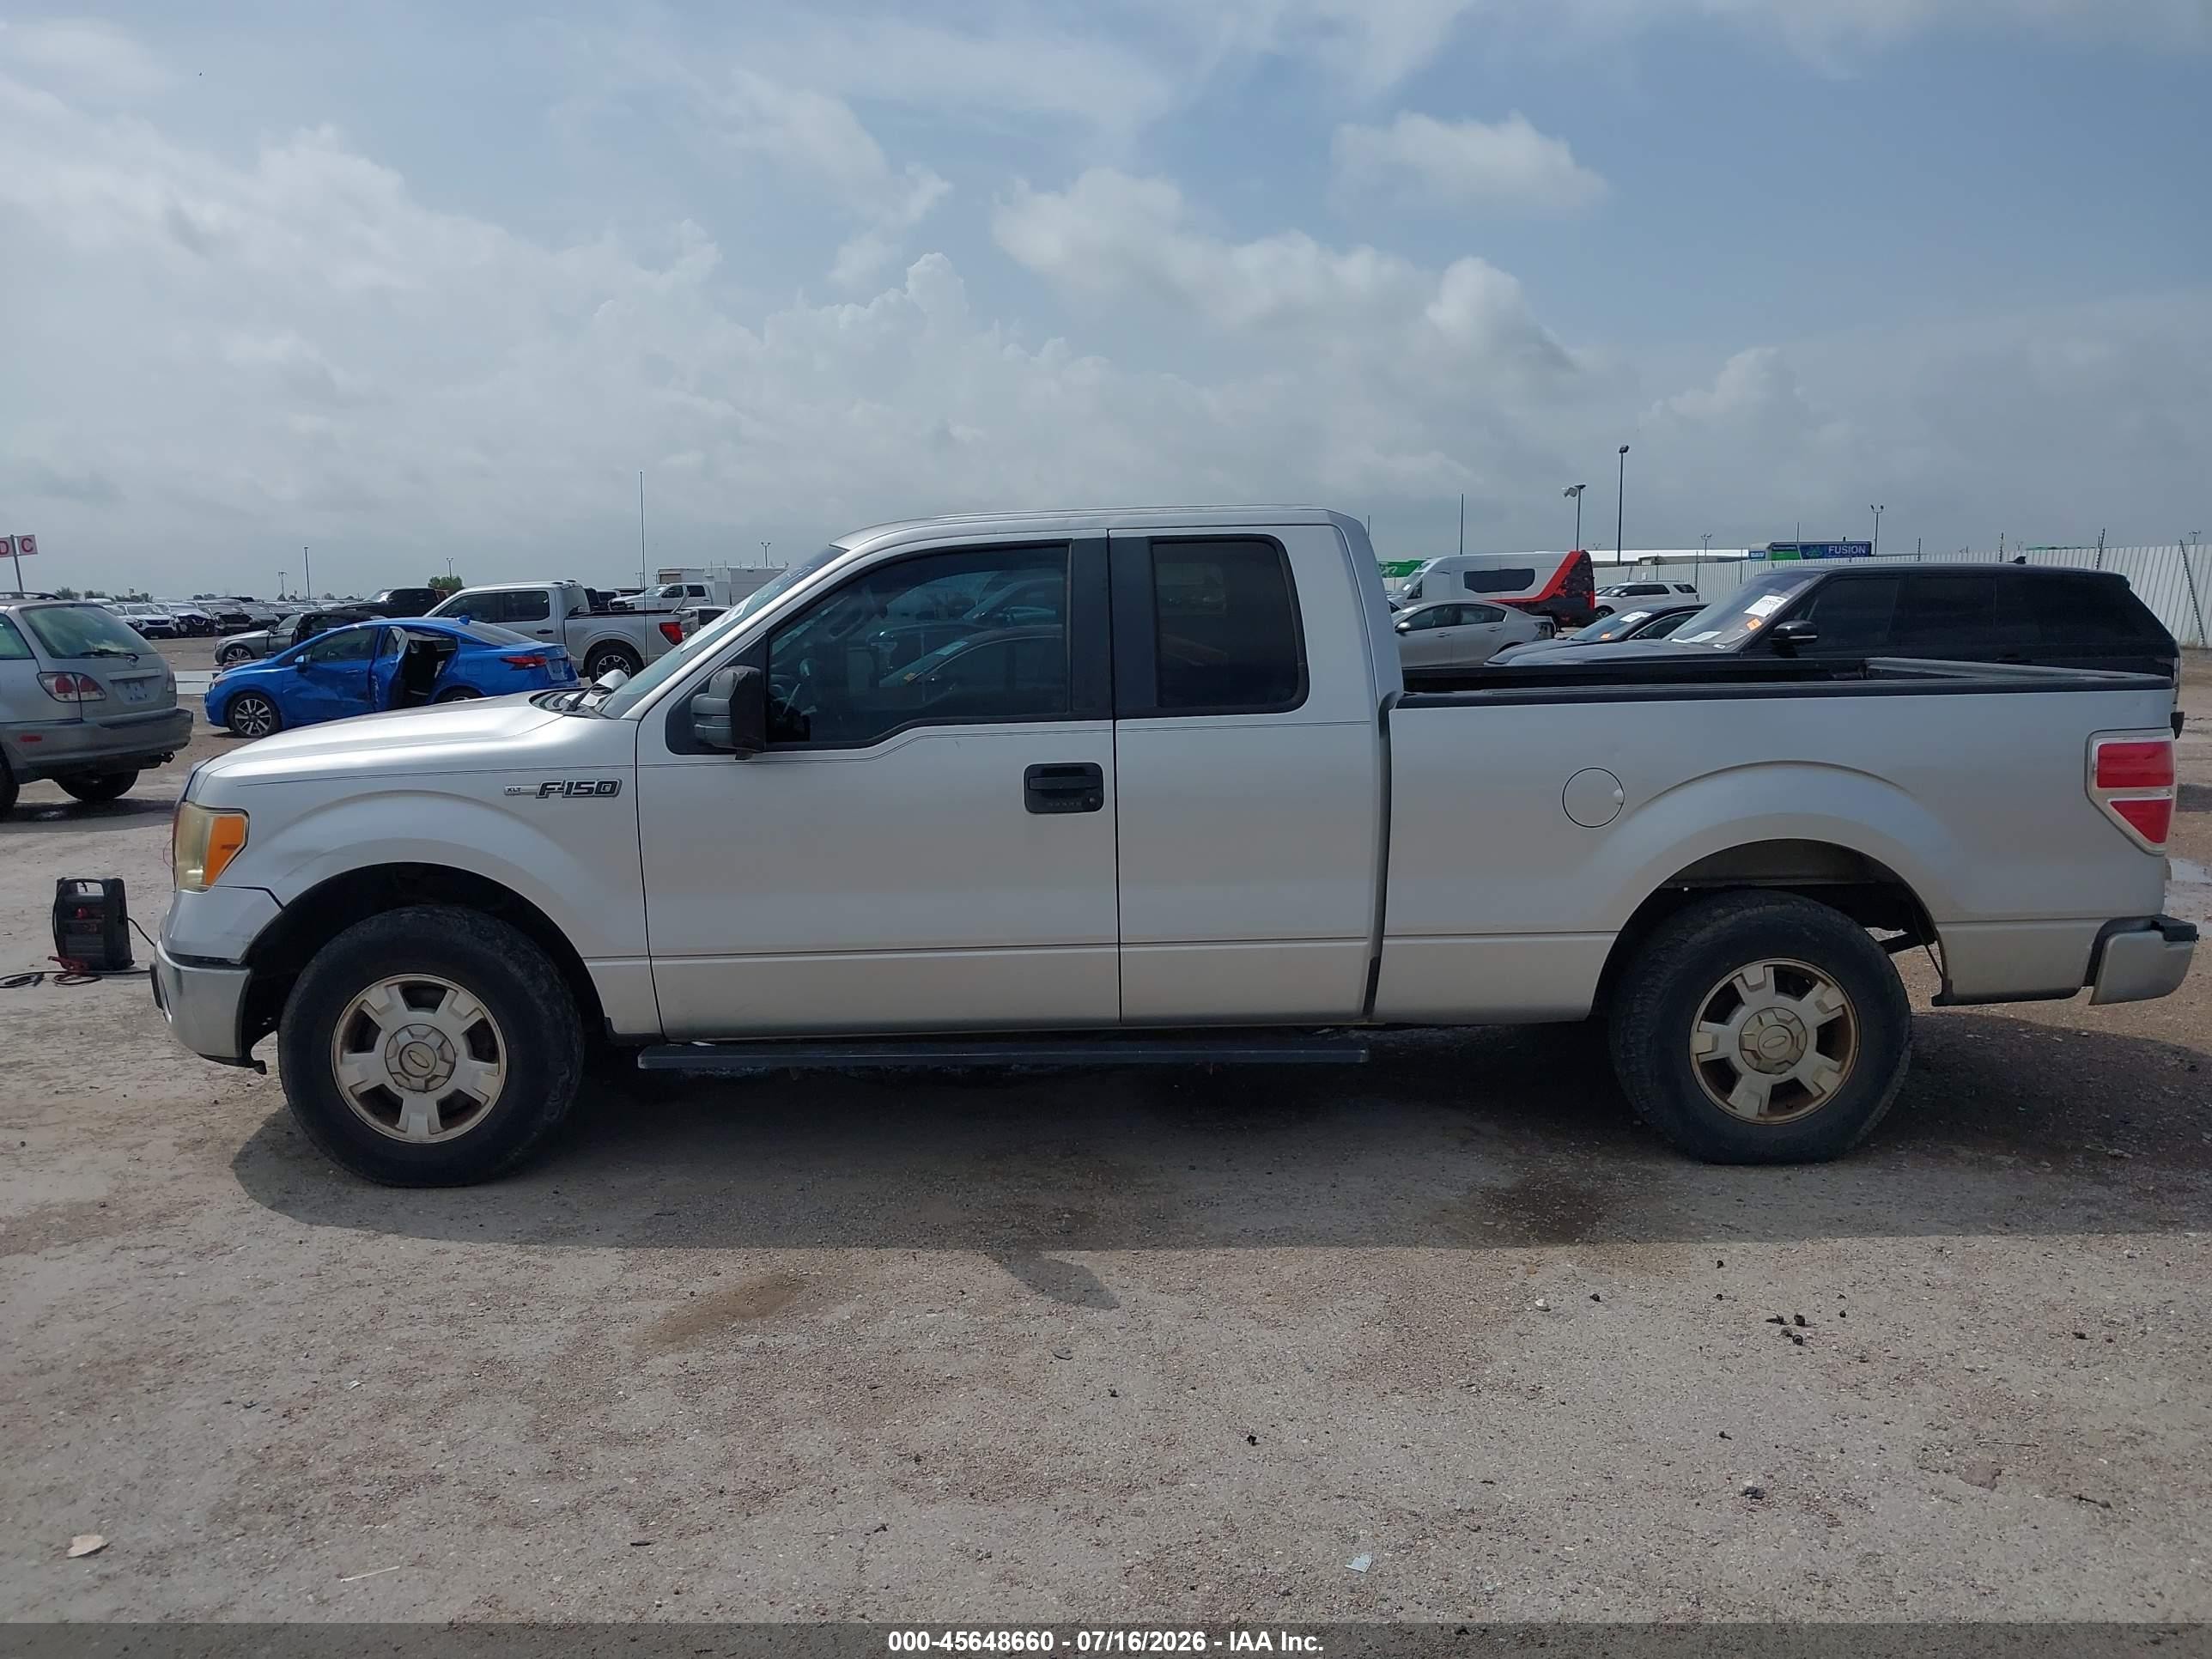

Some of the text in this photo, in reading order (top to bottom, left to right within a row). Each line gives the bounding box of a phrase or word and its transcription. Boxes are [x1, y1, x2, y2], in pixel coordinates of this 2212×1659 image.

[0, 540, 9, 555] D
[21, 538, 33, 552] C
[1828, 544, 1866, 555] FUSION
[537, 779, 623, 799] F-150
